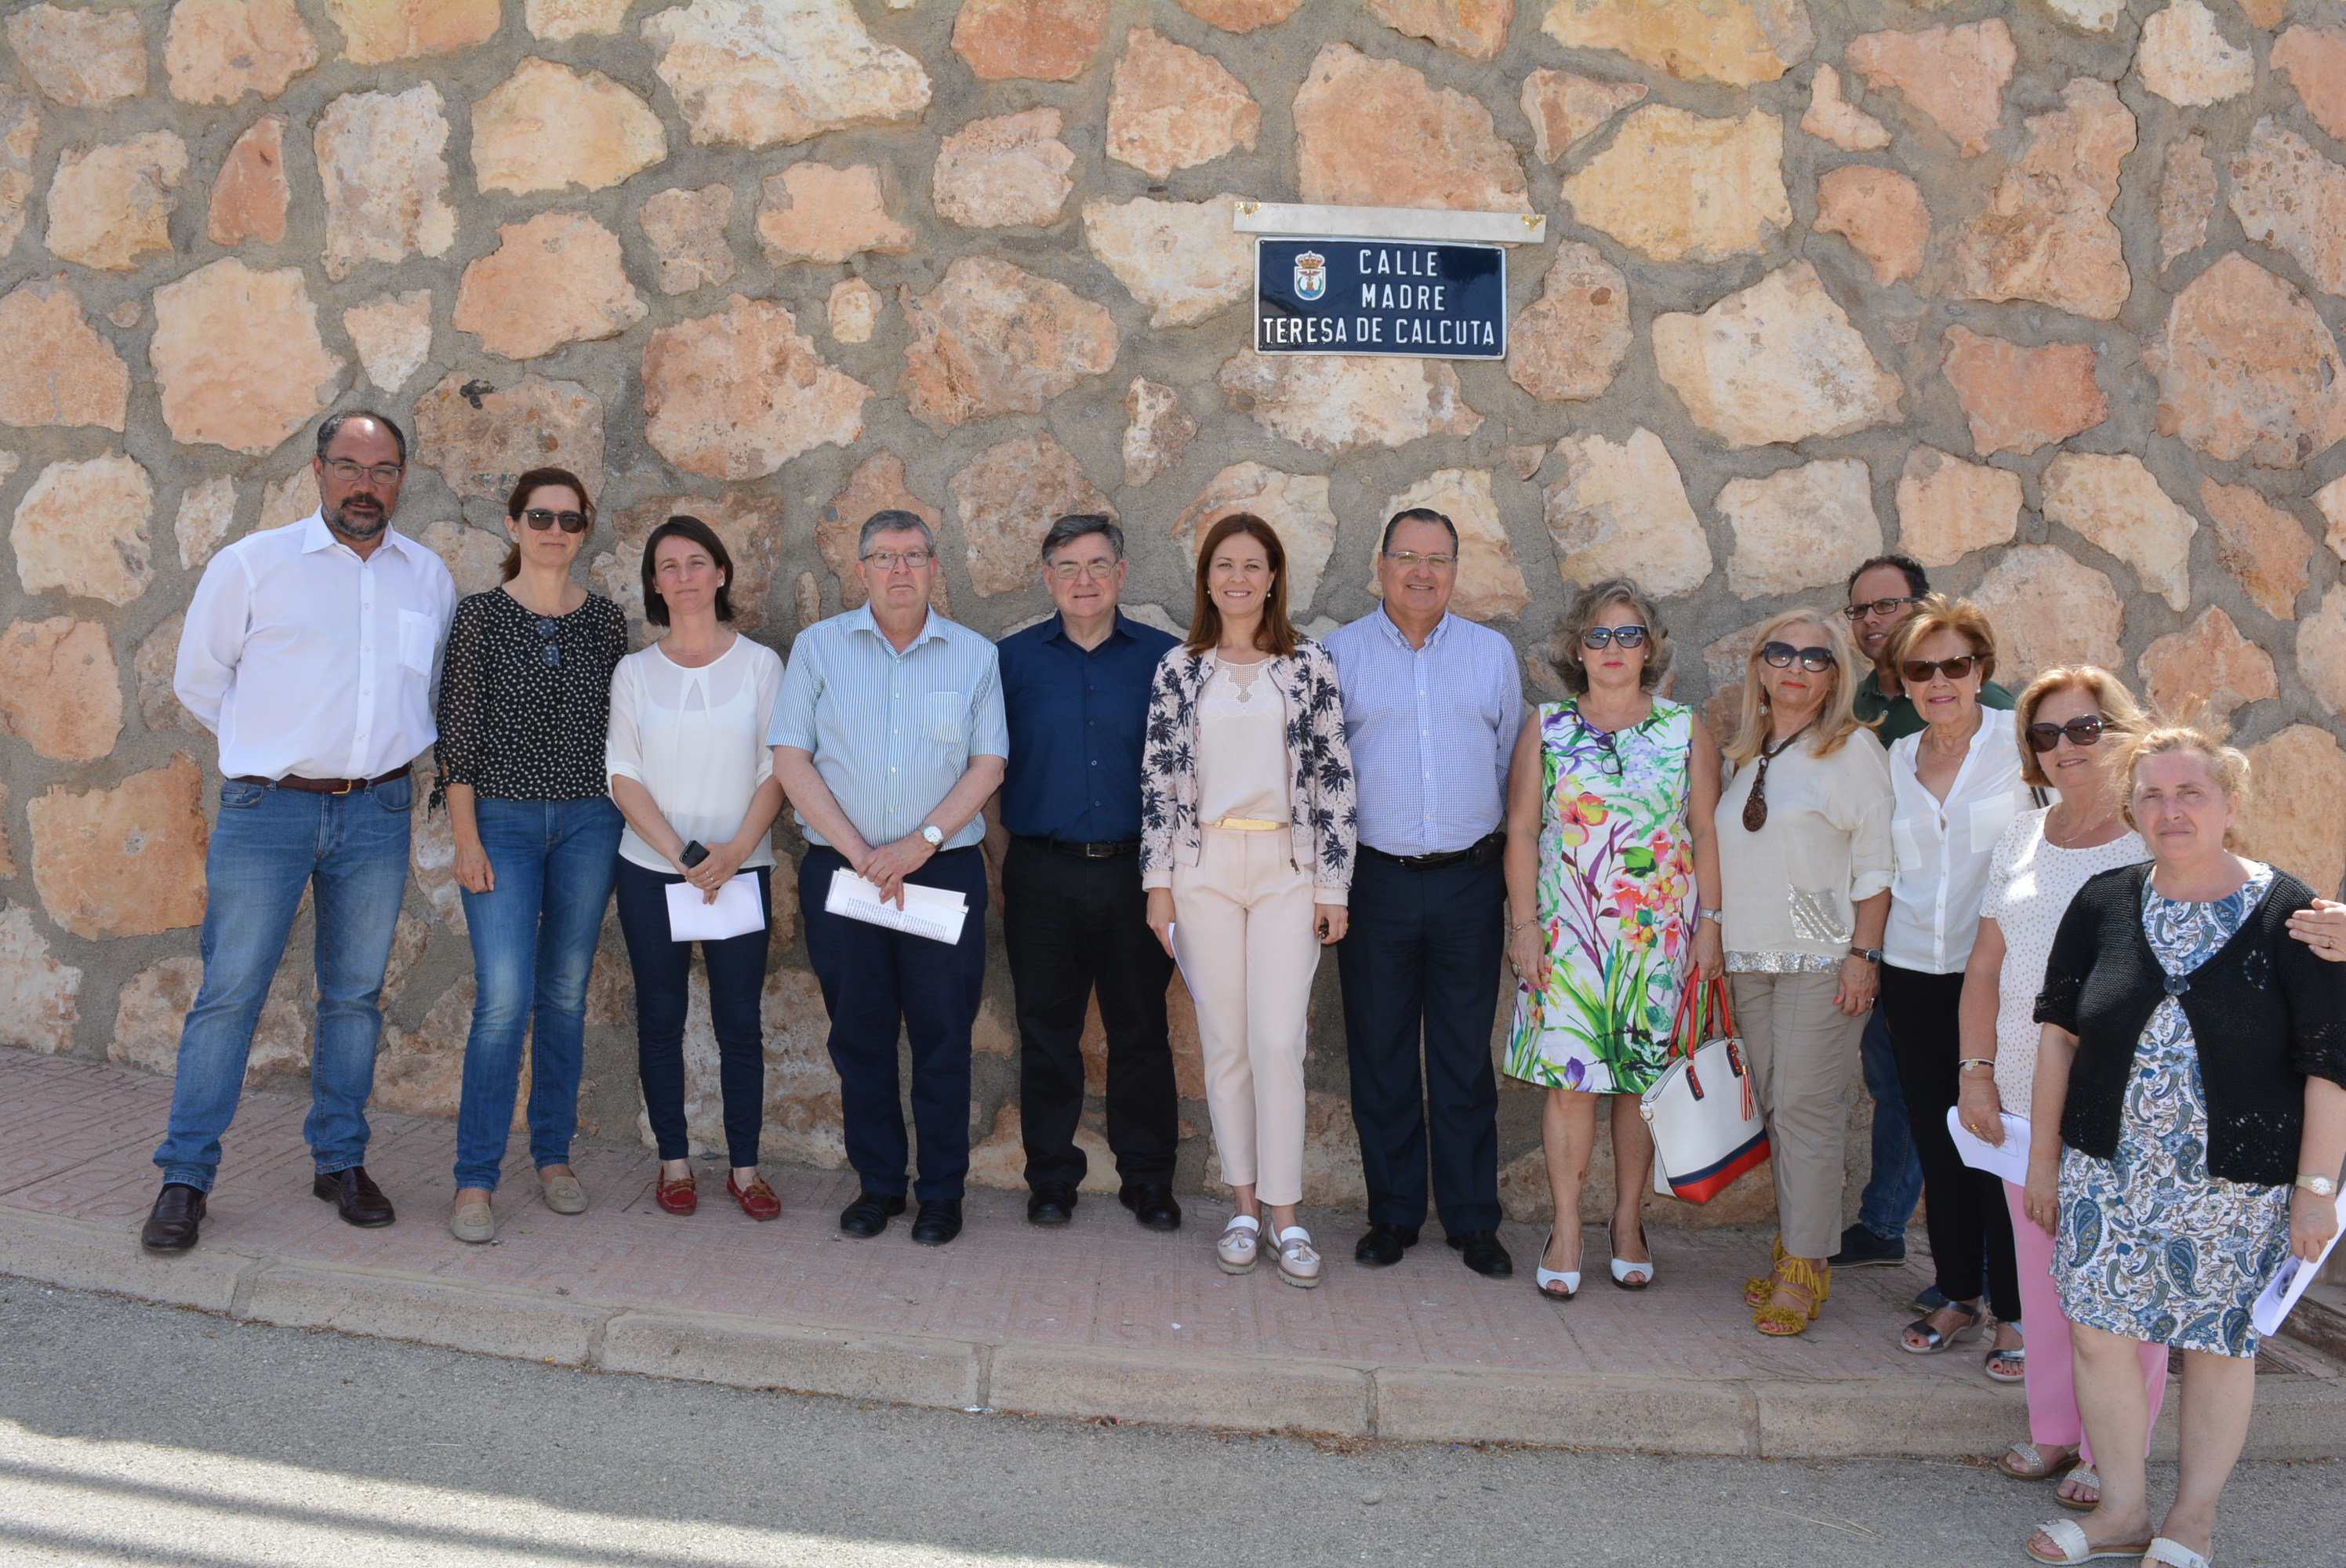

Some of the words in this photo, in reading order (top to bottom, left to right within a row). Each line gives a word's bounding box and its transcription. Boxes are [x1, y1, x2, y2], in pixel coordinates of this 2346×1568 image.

[1359, 249, 1438, 277] CALLE
[1361, 283, 1445, 311] MADRE
[1263, 317, 1347, 343] TERESA
[1356, 317, 1383, 343] DE
[1396, 318, 1494, 346] CALCUTA
